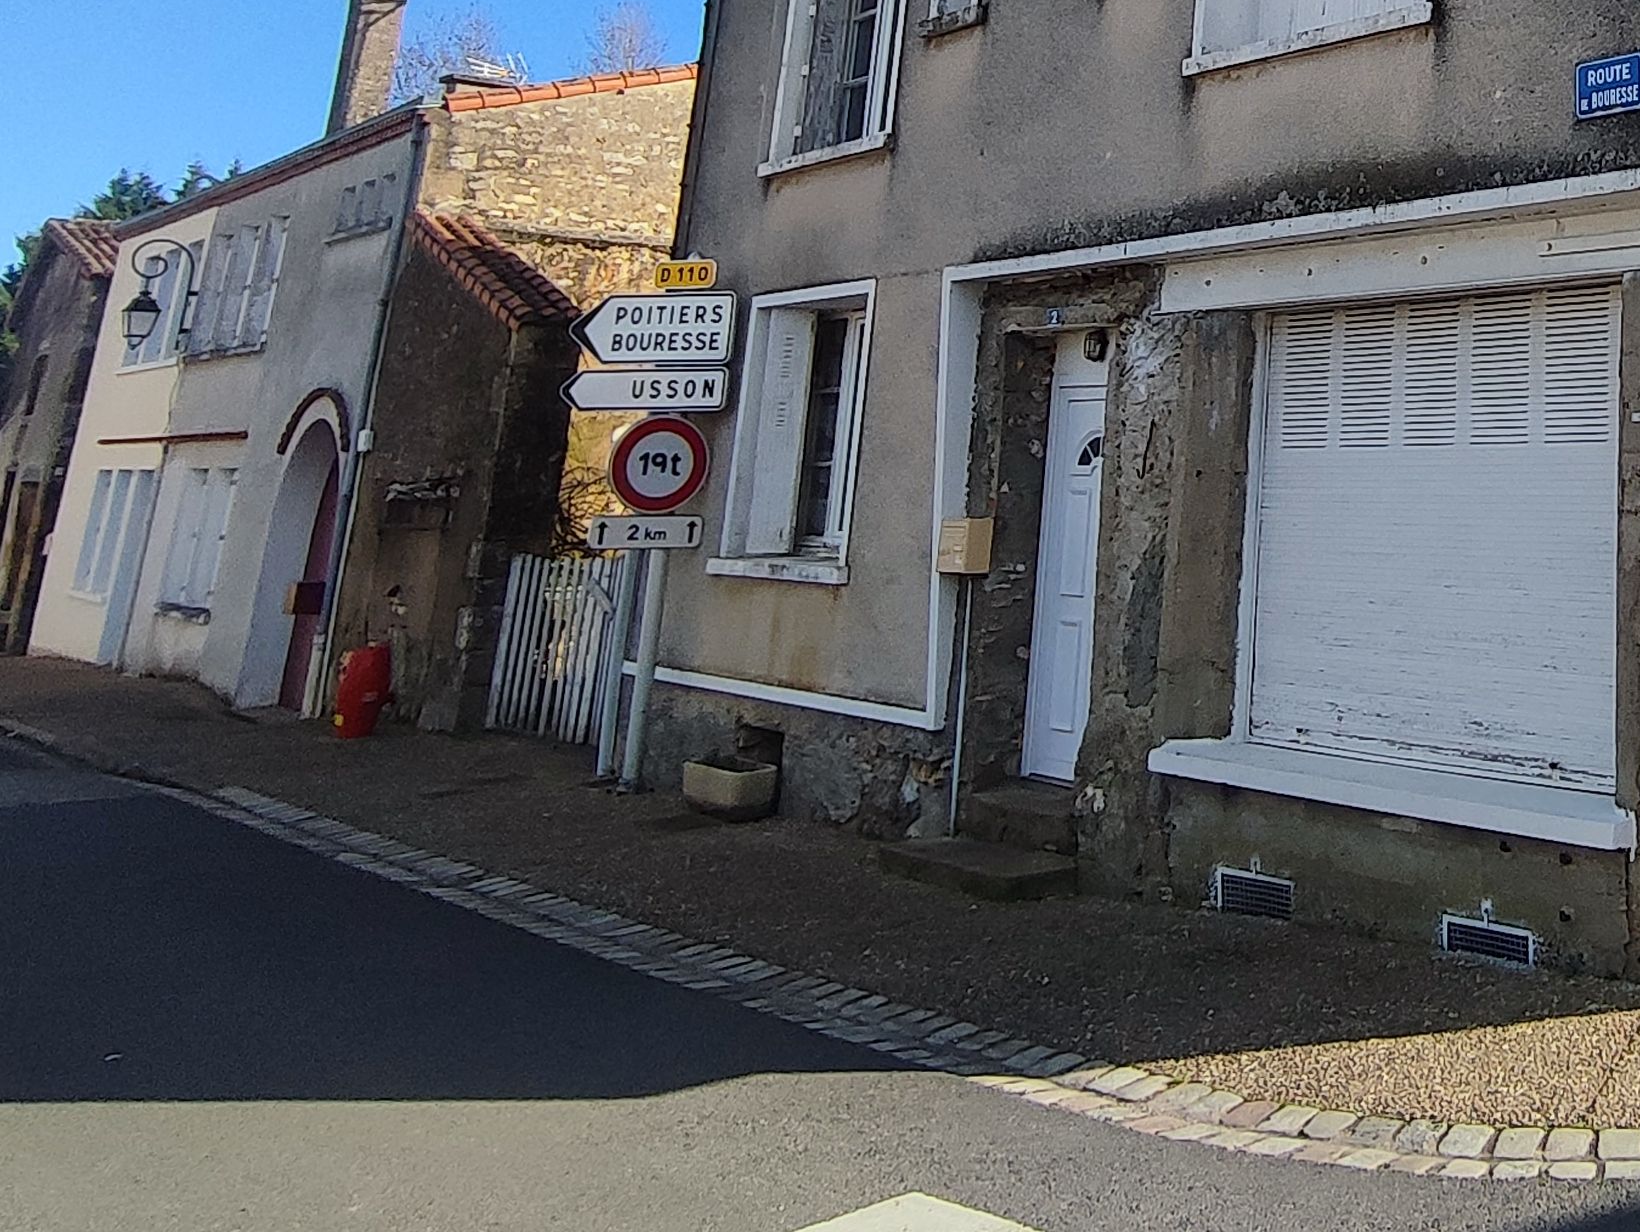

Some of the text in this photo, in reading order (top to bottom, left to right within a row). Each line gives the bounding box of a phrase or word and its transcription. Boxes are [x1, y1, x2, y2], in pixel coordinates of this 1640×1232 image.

[1587, 62, 1632, 87] ROUTE
[1591, 84, 1639, 109] BOURESSE
[660, 266, 709, 283] D 110
[614, 304, 724, 325] POITIERS
[611, 332, 721, 352] BOURESSE
[631, 379, 717, 400] USSON
[638, 451, 683, 477] 19t
[627, 525, 667, 541] 2 km
